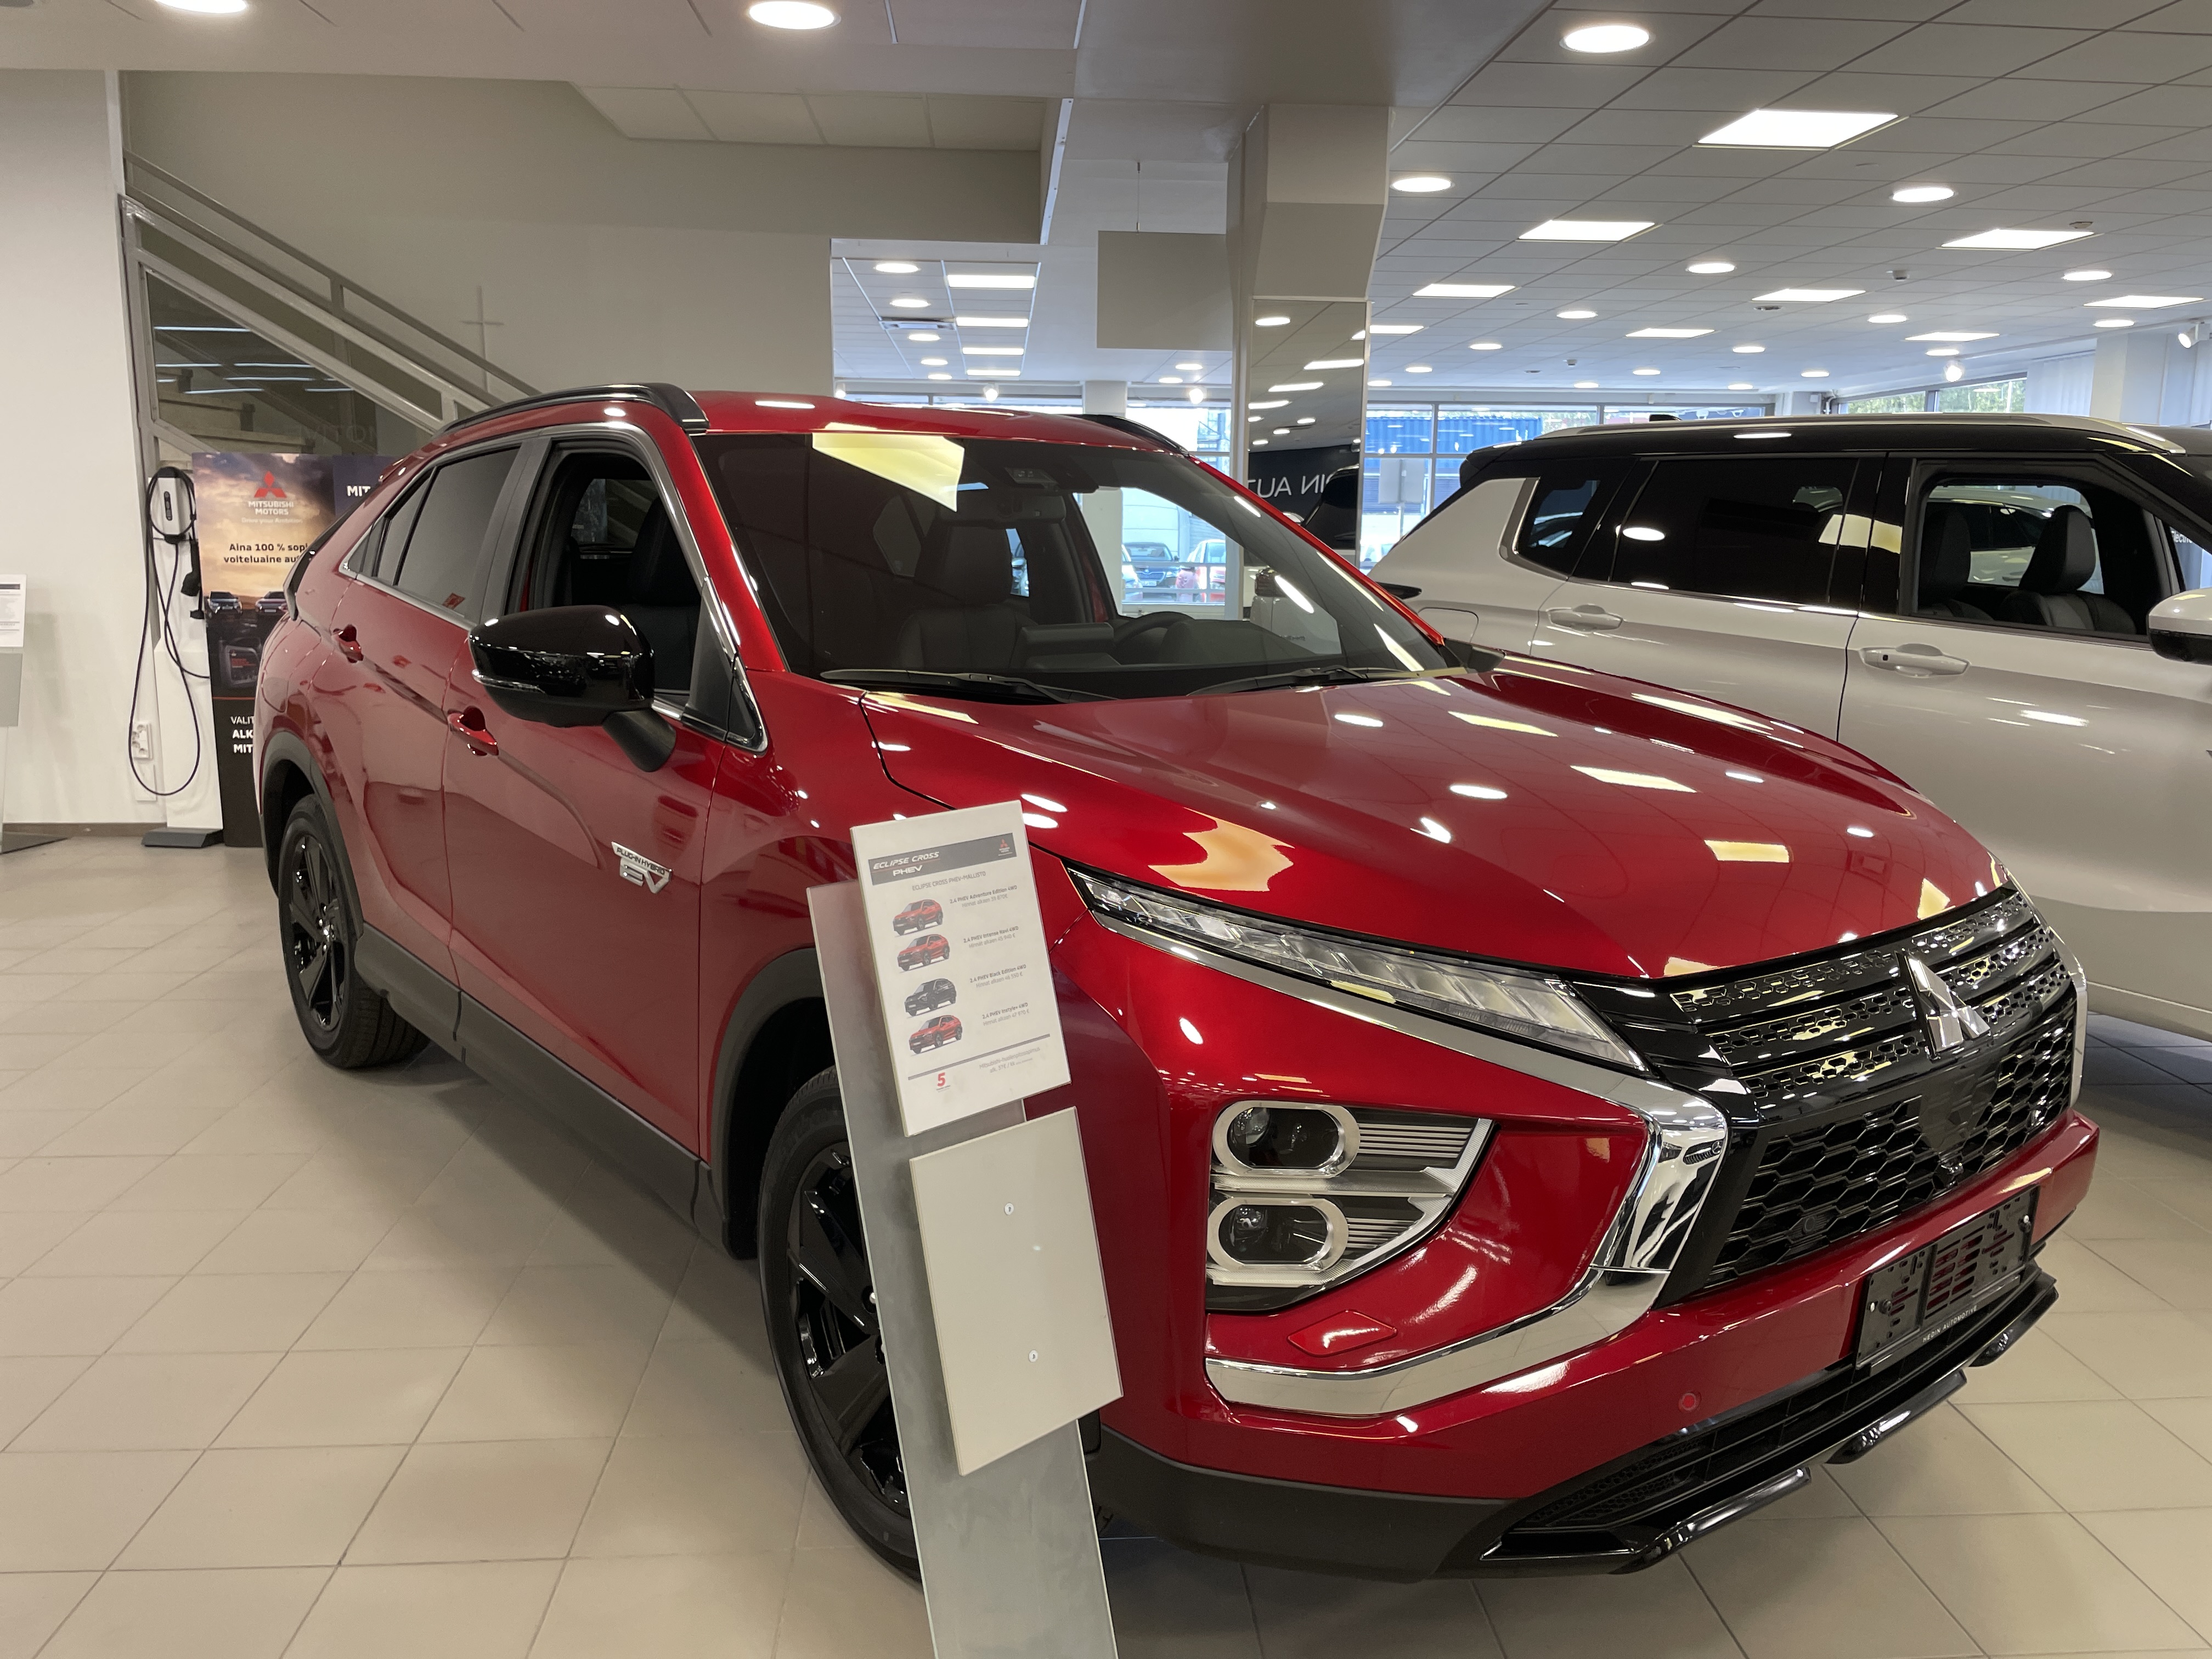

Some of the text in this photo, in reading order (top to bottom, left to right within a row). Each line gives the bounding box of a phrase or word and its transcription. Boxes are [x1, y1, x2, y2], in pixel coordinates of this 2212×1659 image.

[347, 485, 371, 496] MIT
[224, 555, 281, 563] voiteluaine
[233, 730, 253, 738] ALK
[233, 744, 253, 753] MIT
[617, 847, 665, 875] PLUG-IN HYBRID
[873, 851, 940, 870] ECLIPSE CROSS
[893, 865, 923, 877] PHEV
[912, 871, 986, 891] ECLIPSE CROSS PHEV-MALLISTO
[969, 891, 992, 899] Adventure
[937, 1072, 946, 1087] 5
[1923, 1305, 1977, 1342] HEDIN AUTOMOTIVE
